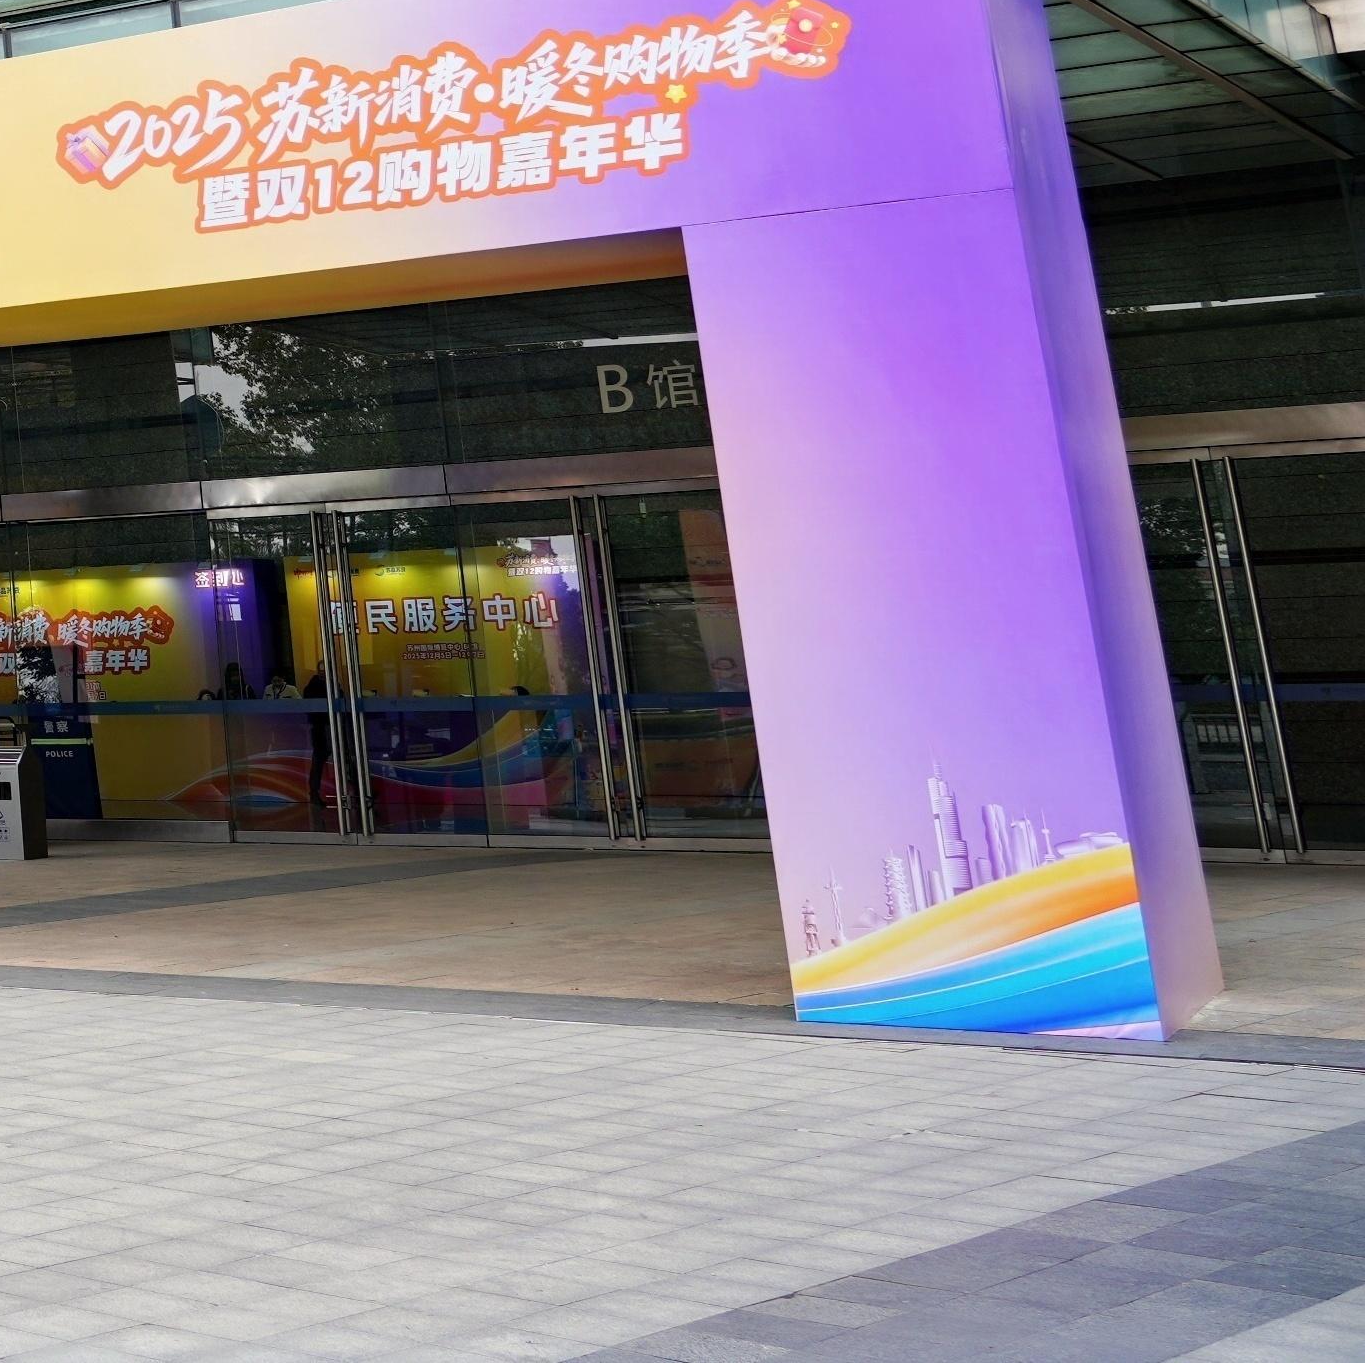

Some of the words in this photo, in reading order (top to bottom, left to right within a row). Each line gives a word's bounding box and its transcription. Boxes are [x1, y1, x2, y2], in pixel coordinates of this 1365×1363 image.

[101, 89, 242, 182] 2025
[200, 112, 683, 228] 暨双12购物嘉年华
[44, 720, 69, 734] 警察
[45, 750, 74, 758] POLICE
